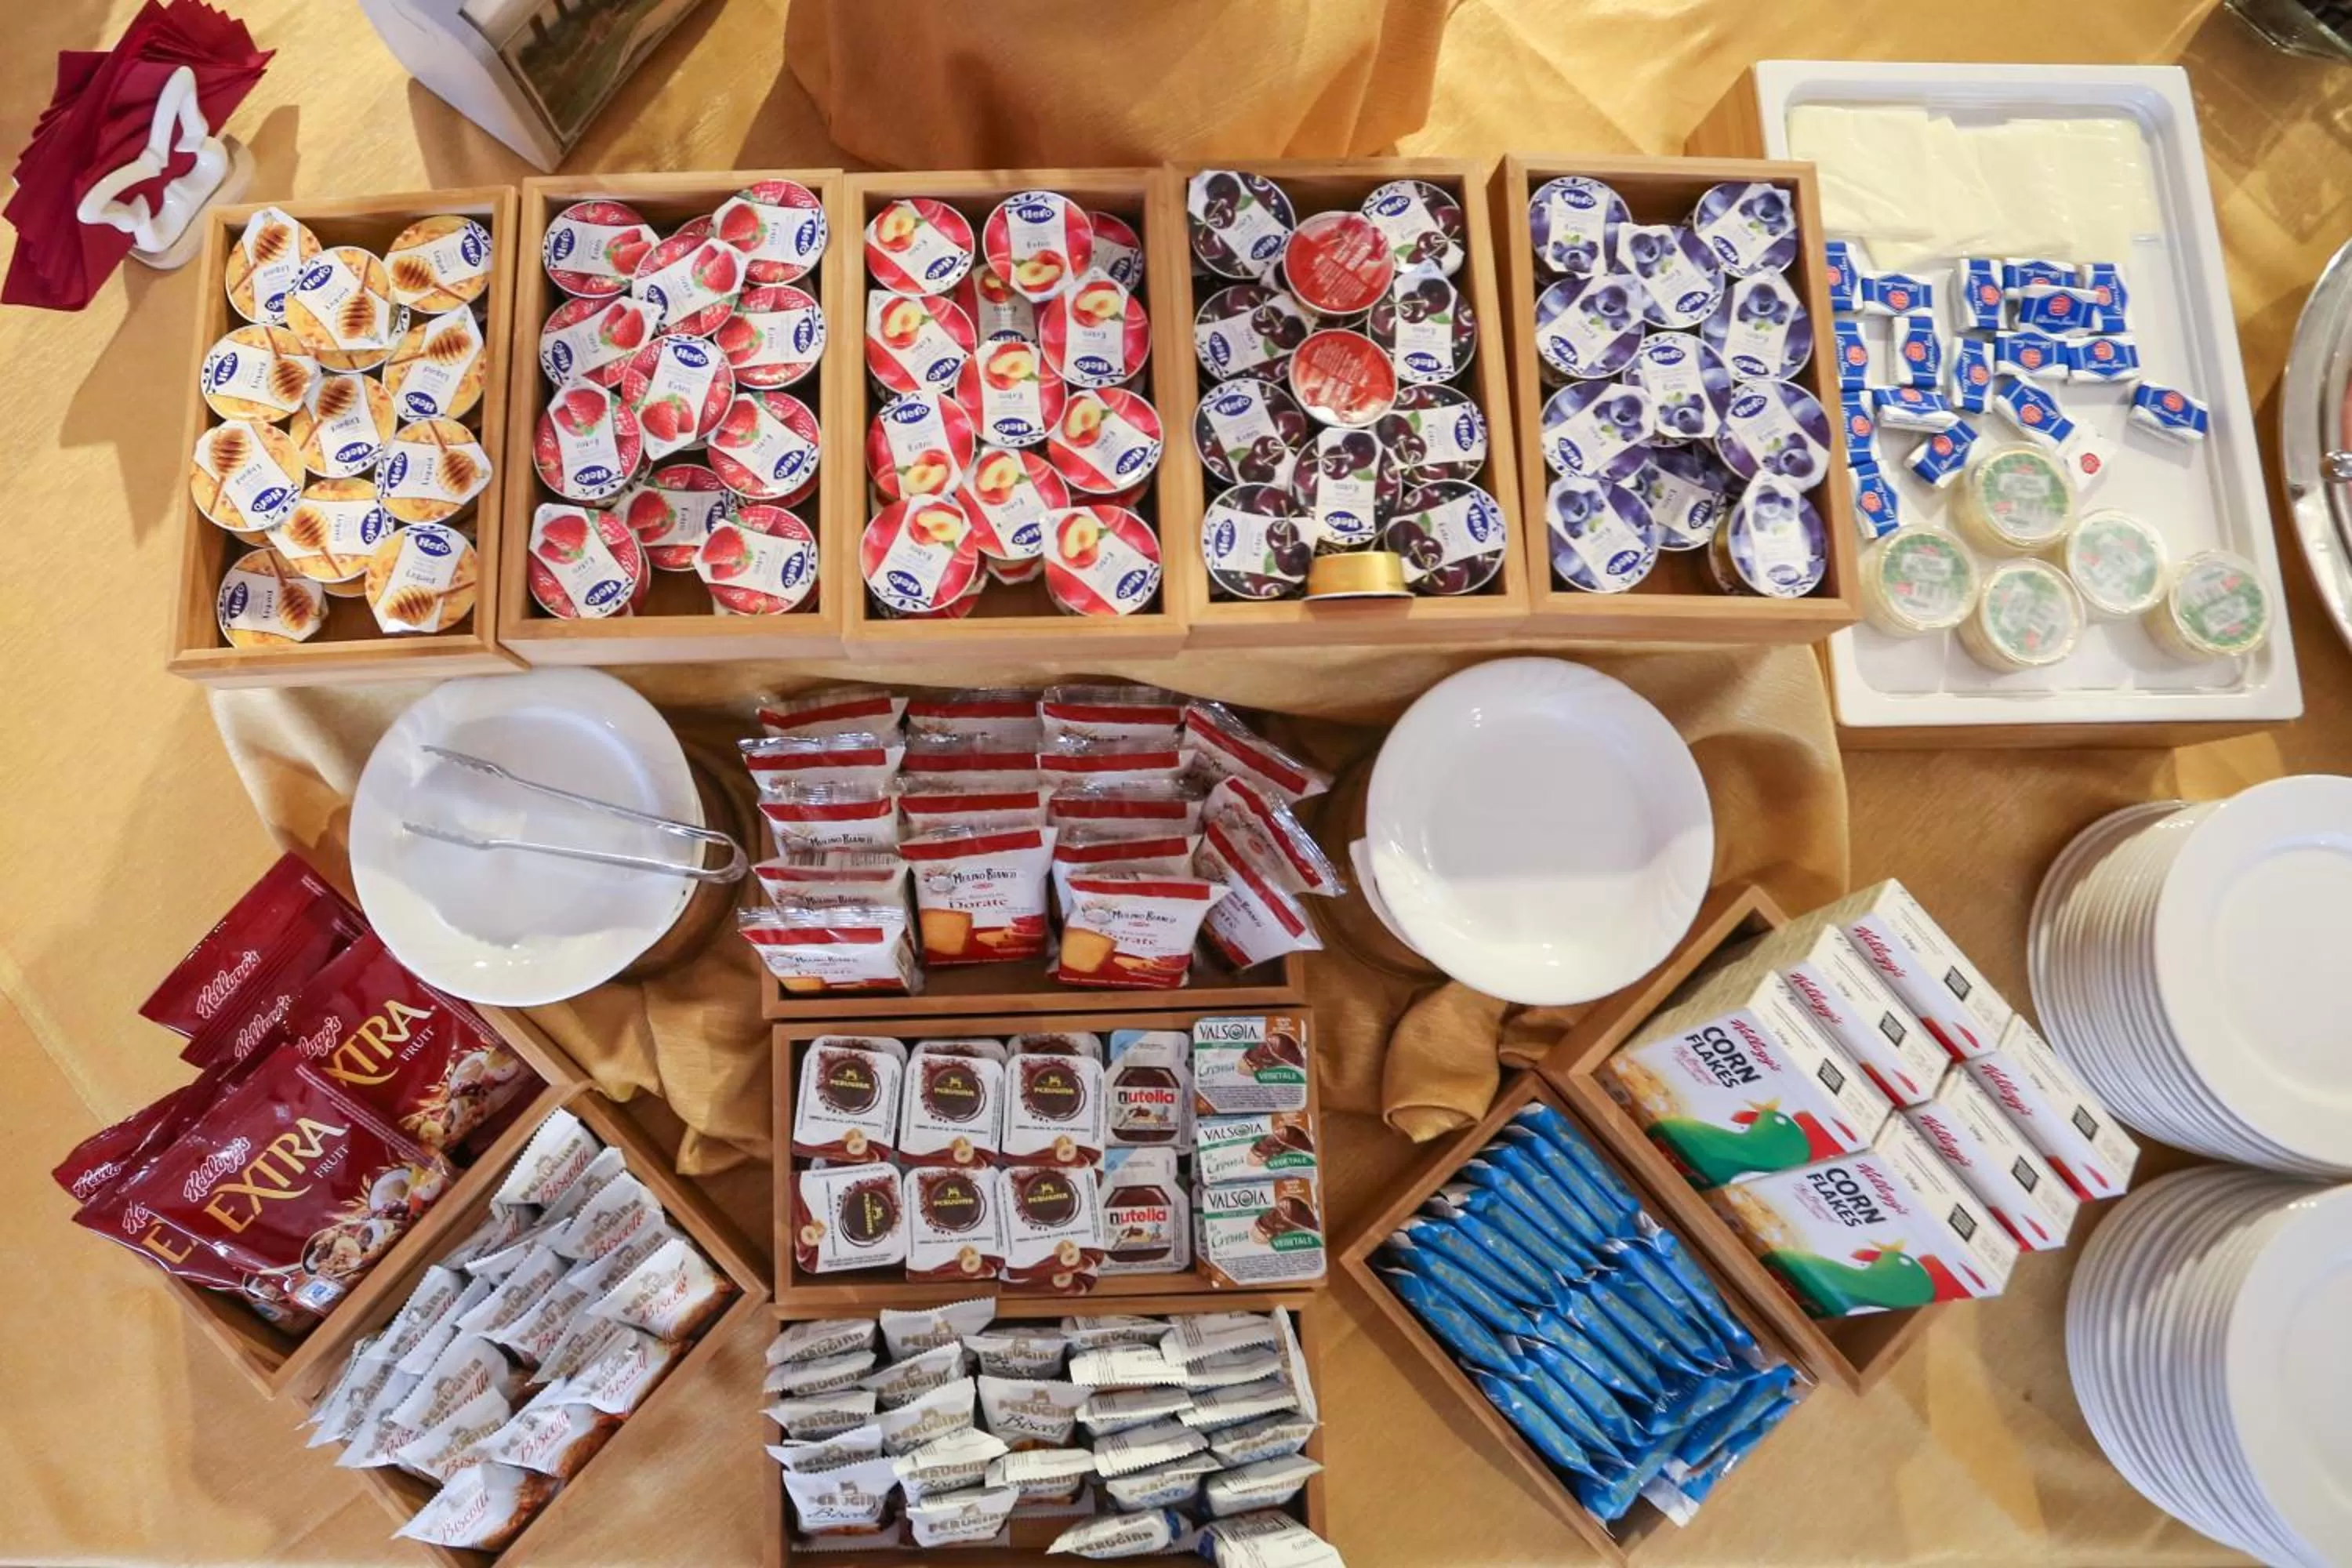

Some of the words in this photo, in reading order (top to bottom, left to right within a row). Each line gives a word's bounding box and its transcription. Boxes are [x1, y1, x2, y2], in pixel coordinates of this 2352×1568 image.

[1380, 198, 1408, 215] Hero
[1563, 193, 1594, 206] Hero
[1021, 208, 1052, 221] Hero
[799, 222, 815, 254] Hero
[463, 238, 479, 264] Hero
[303, 267, 331, 290] Hero
[927, 257, 956, 279] Hero
[1679, 293, 1707, 310] Hero
[797, 318, 811, 351] Hero
[676, 347, 706, 364] Hero
[1551, 337, 1577, 362] Hero
[1650, 350, 1682, 361] Hero
[217, 354, 236, 384] Hero
[928, 359, 958, 380] Hero
[1080, 360, 1109, 372] Hero
[1407, 357, 1439, 368] Hero
[1735, 358, 1767, 374] Hero
[407, 395, 435, 413] Hero
[897, 405, 927, 423] Hero
[1220, 397, 1250, 413] Hero
[1734, 397, 1764, 416] Hero
[997, 422, 1029, 434] Hero
[1457, 419, 1473, 449] Hero
[338, 444, 371, 461] Hero
[1119, 448, 1147, 472] Hero
[390, 454, 406, 487] Hero
[776, 452, 804, 477] Hero
[577, 470, 608, 485] Hero
[254, 488, 286, 510] Hero
[365, 509, 380, 542] Hero
[1329, 516, 1361, 528] Hero
[1470, 509, 1486, 539] Hero
[419, 539, 448, 552] Hero
[1218, 521, 1232, 555] Hero
[785, 554, 804, 586] Hero
[1608, 551, 1639, 574] Hero
[588, 581, 619, 604] Hero
[890, 572, 920, 595] Hero
[1119, 572, 1146, 597] Hero
[1855, 926, 1906, 978] Kellogg's
[197, 950, 261, 1019] Kellogg's
[1791, 972, 1842, 1025] Kellogg's
[235, 995, 292, 1059] Kellogg's
[1199, 1024, 1258, 1040] VALSOIA
[321, 1000, 431, 1087] XTRA
[401, 1027, 434, 1062] FRUIT
[1730, 1019, 1782, 1073] Kellogg's
[1686, 1034, 1740, 1089] FLAKES
[1703, 1026, 1762, 1085] CORN
[830, 1079, 871, 1089] PERUGINA
[1259, 1071, 1297, 1080] VEGETALE
[934, 1087, 975, 1098] PERUGINA
[1034, 1087, 1075, 1095] PERUGINA
[1118, 1089, 1175, 1105] nutella
[1982, 1063, 2033, 1116] Kellogg's
[1204, 1123, 1265, 1142] VALSOIA
[1920, 1114, 1973, 1167] Kellogg's
[184, 1136, 250, 1202] Kellogg's
[314, 1145, 348, 1178] FRUIT
[1269, 1156, 1308, 1167] VEGETALE
[204, 1117, 347, 1234] EXTRA
[540, 1147, 590, 1203] Biscotti
[1028, 1193, 1069, 1204] PERUGINA
[1208, 1189, 1268, 1209] VALSOIA
[1826, 1167, 1886, 1225] CORN
[1857, 1163, 1909, 1215] Kellogg's
[933, 1197, 975, 1207] PERUGINA
[1807, 1174, 1863, 1228] FLAKES
[864, 1193, 873, 1235] PERUGINA
[1110, 1208, 1167, 1225] nutella
[1274, 1237, 1312, 1248] VEGETALE
[521, 1408, 570, 1461] Biscotti
[441, 1491, 489, 1544] Biscotti
